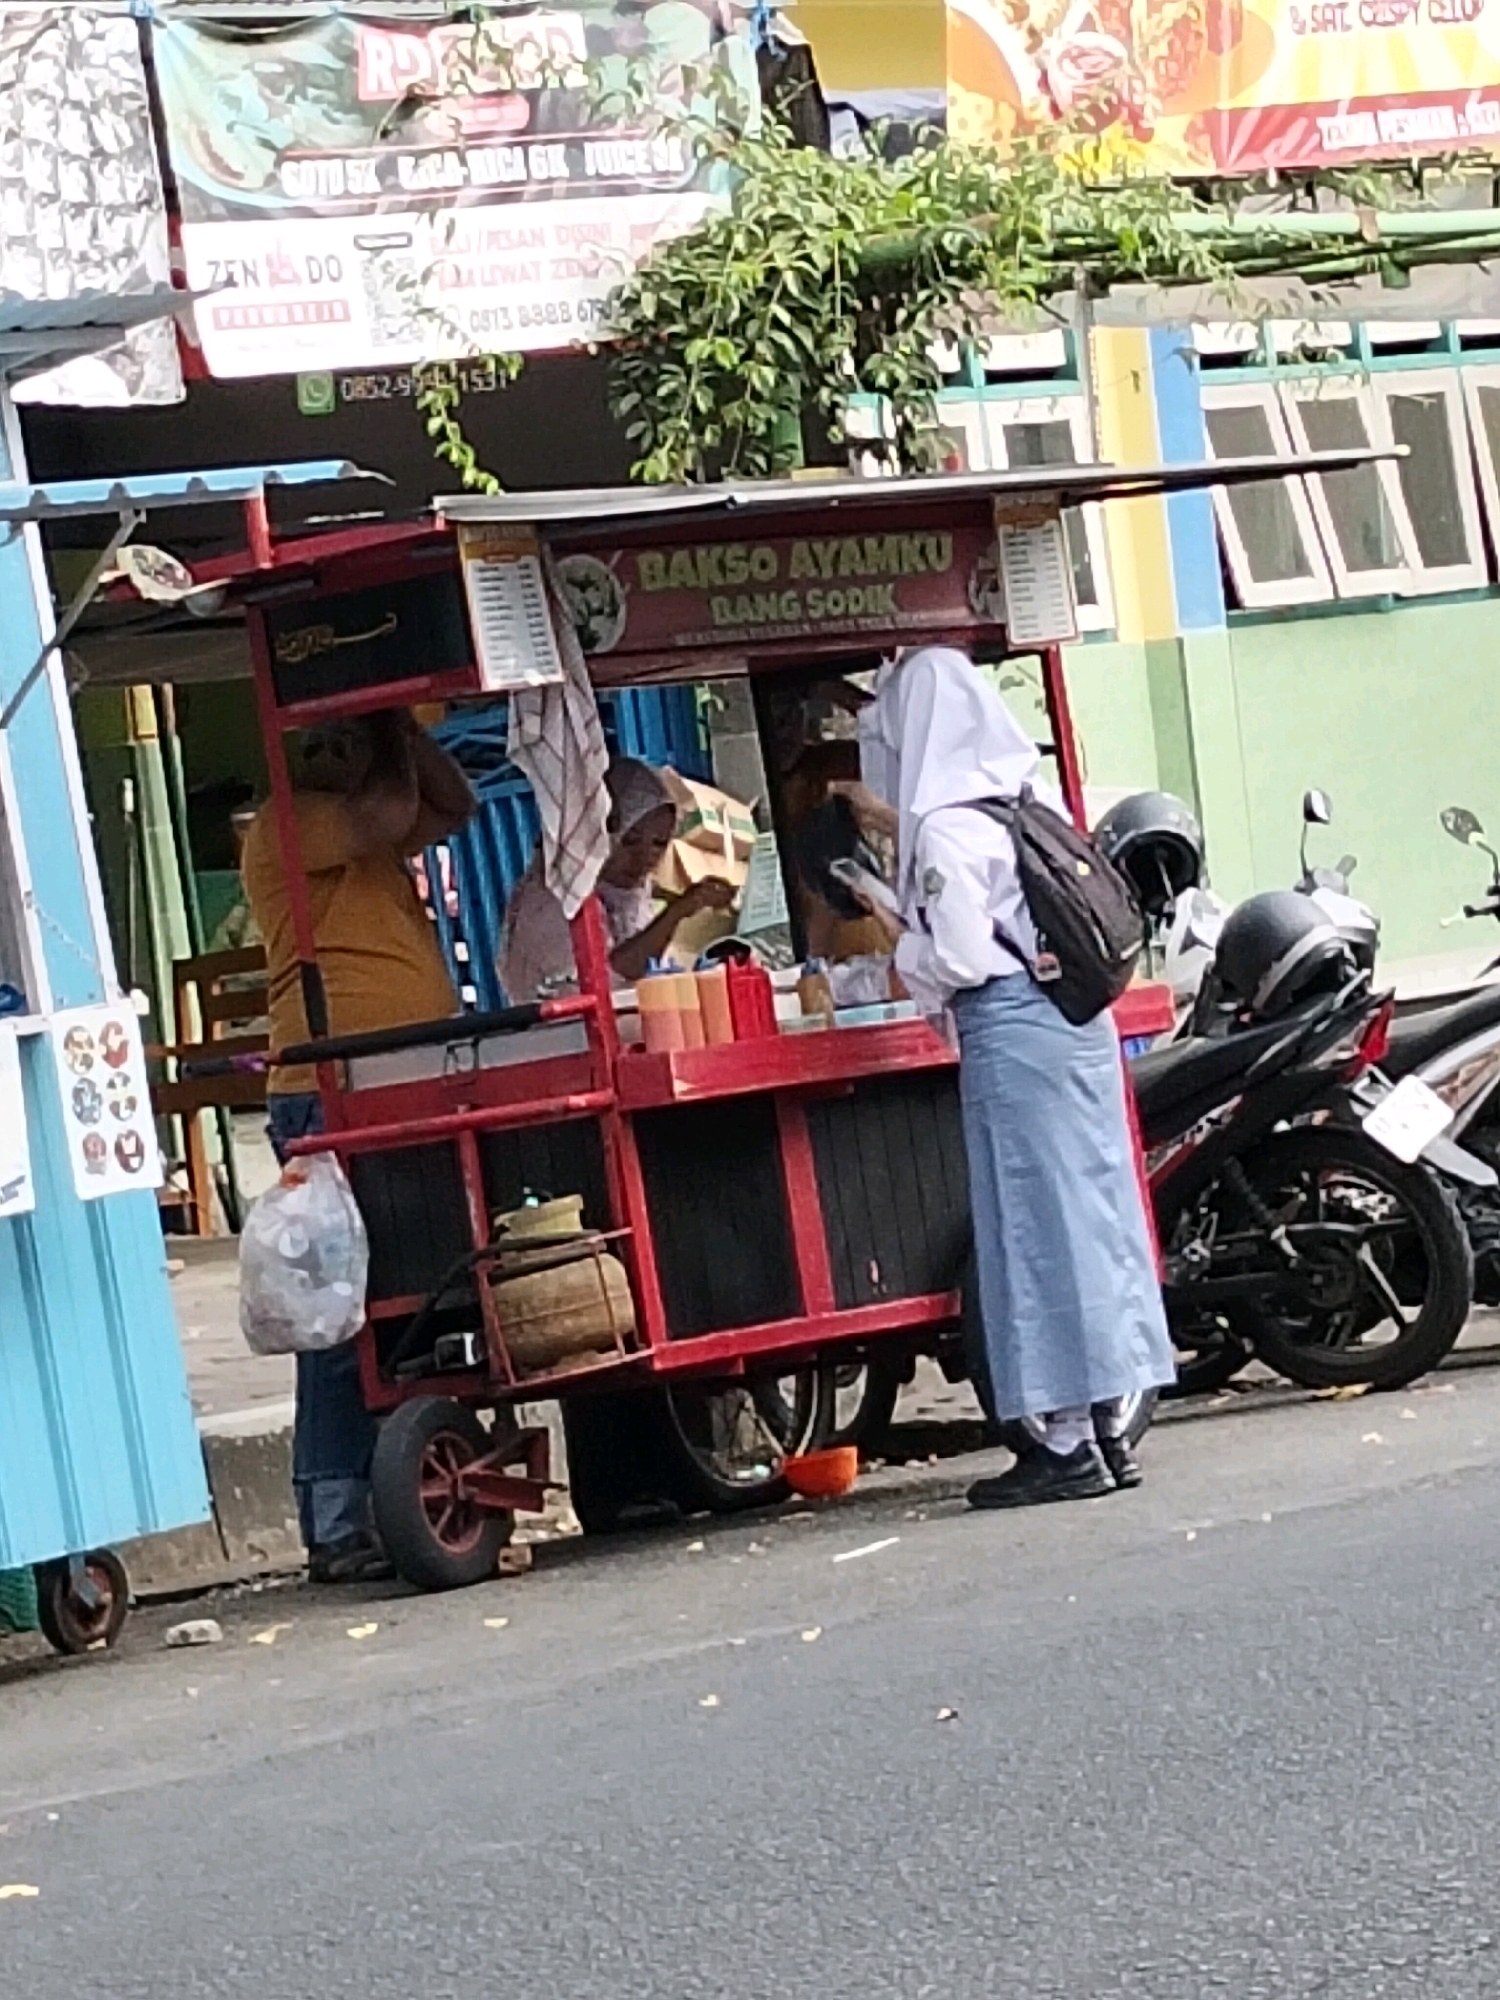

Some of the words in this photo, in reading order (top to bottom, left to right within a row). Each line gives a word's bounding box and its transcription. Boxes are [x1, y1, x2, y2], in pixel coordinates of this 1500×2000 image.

[638, 546, 777, 591] BAKSO
[789, 531, 953, 580] AYAMKU
[806, 582, 896, 619] SODIK
